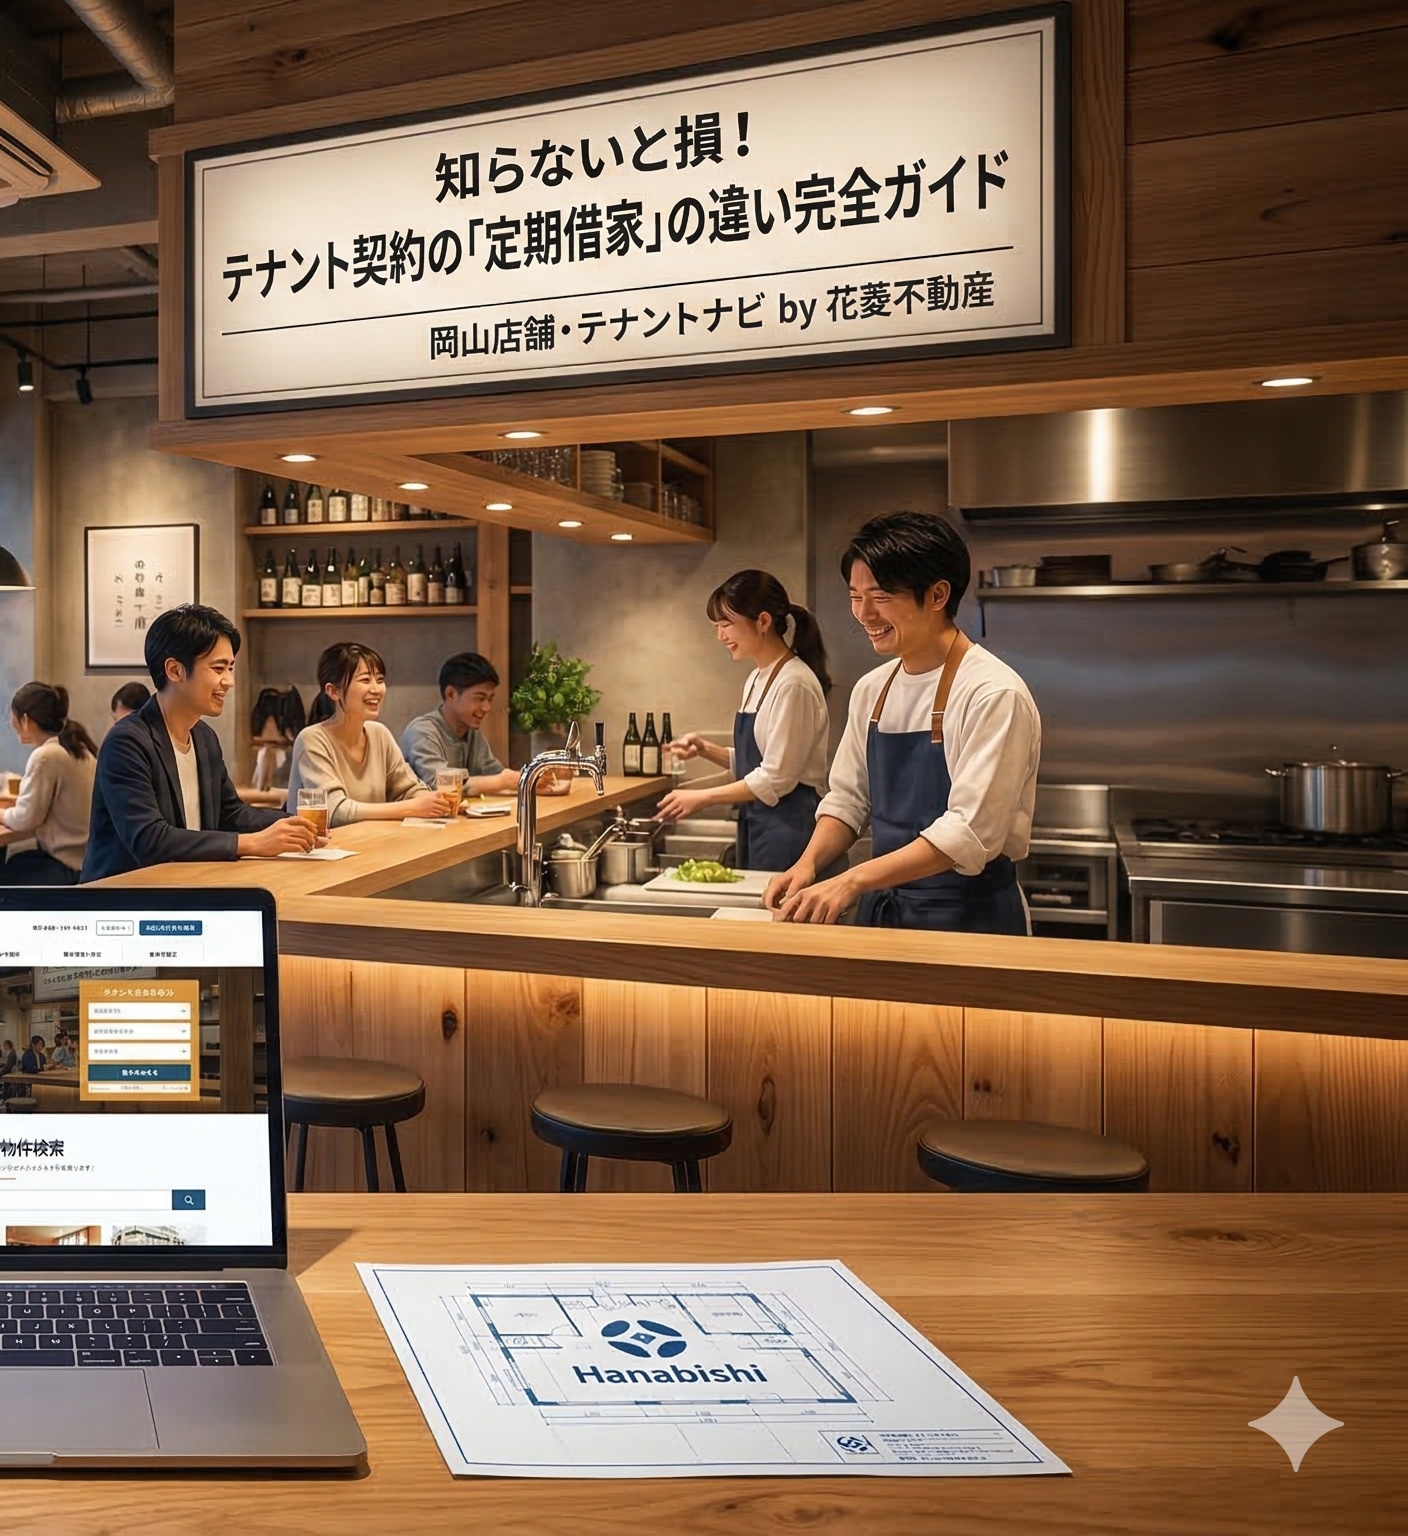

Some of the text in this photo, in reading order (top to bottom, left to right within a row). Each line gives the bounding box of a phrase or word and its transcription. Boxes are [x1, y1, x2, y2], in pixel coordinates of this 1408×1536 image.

[435, 111, 750, 204] 知らないと損！
[222, 149, 1009, 303] テナント契約の「定期借家」の違い完全ガイド
[429, 270, 995, 361] 岡山店舗・テナントナビ by 花菱不動産
[572, 1363, 768, 1385] Hanabishi
